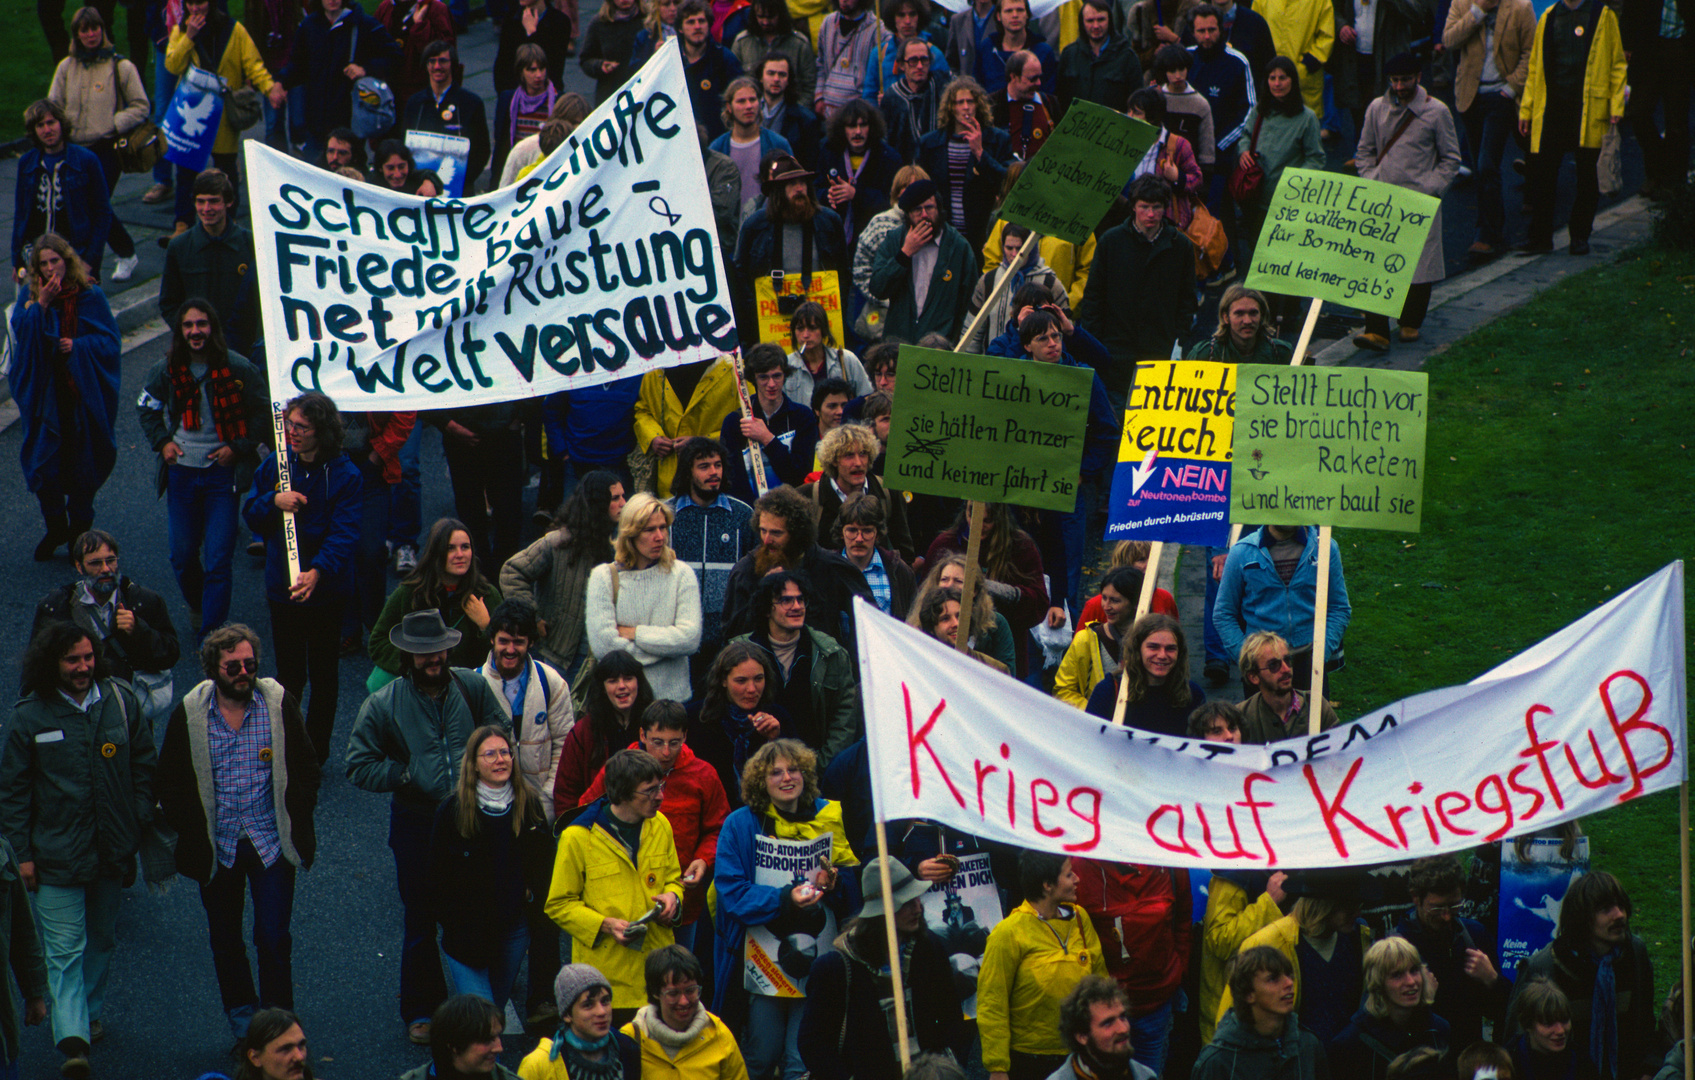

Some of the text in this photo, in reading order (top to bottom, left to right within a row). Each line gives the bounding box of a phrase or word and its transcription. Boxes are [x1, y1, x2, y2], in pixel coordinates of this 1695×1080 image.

[1062, 110, 1105, 142] Stellt
[1095, 122, 1130, 154] Euch
[1091, 169, 1122, 204] Krieg
[1284, 175, 1343, 208] Stellt
[1346, 186, 1393, 219] Euch
[1008, 201, 1036, 217] und
[1031, 202, 1067, 230] keiner
[1274, 206, 1300, 222] sie
[1359, 218, 1401, 244] Geld
[274, 231, 462, 298] Friede
[486, 184, 611, 269] baue
[1267, 223, 1375, 264] für Bomben
[280, 228, 718, 350] net mit Rüstung
[1257, 260, 1394, 300] und keiner gäb's
[493, 290, 740, 383] versaue
[913, 364, 1081, 411] Stellt Euch vor,
[1251, 373, 1422, 418] Stellt Euch vor,
[910, 411, 1074, 448] sie hätten Panzer
[1249, 410, 1401, 442] sie bräuchten
[898, 460, 1073, 497] und keiner fährt sie
[1161, 464, 1228, 492] NEIN
[1318, 445, 1417, 479] Raketen
[1242, 484, 1415, 514] und keiner baut sie
[1109, 510, 1224, 534] Frieden durch Abrüstung
[900, 669, 1675, 868] Krieg auf Kriegsfuß
[755, 852, 813, 872] BEDROHEN
[968, 869, 993, 888] DICH
[1503, 938, 1529, 949] Keine
[748, 938, 797, 995] Frieden sichern!
